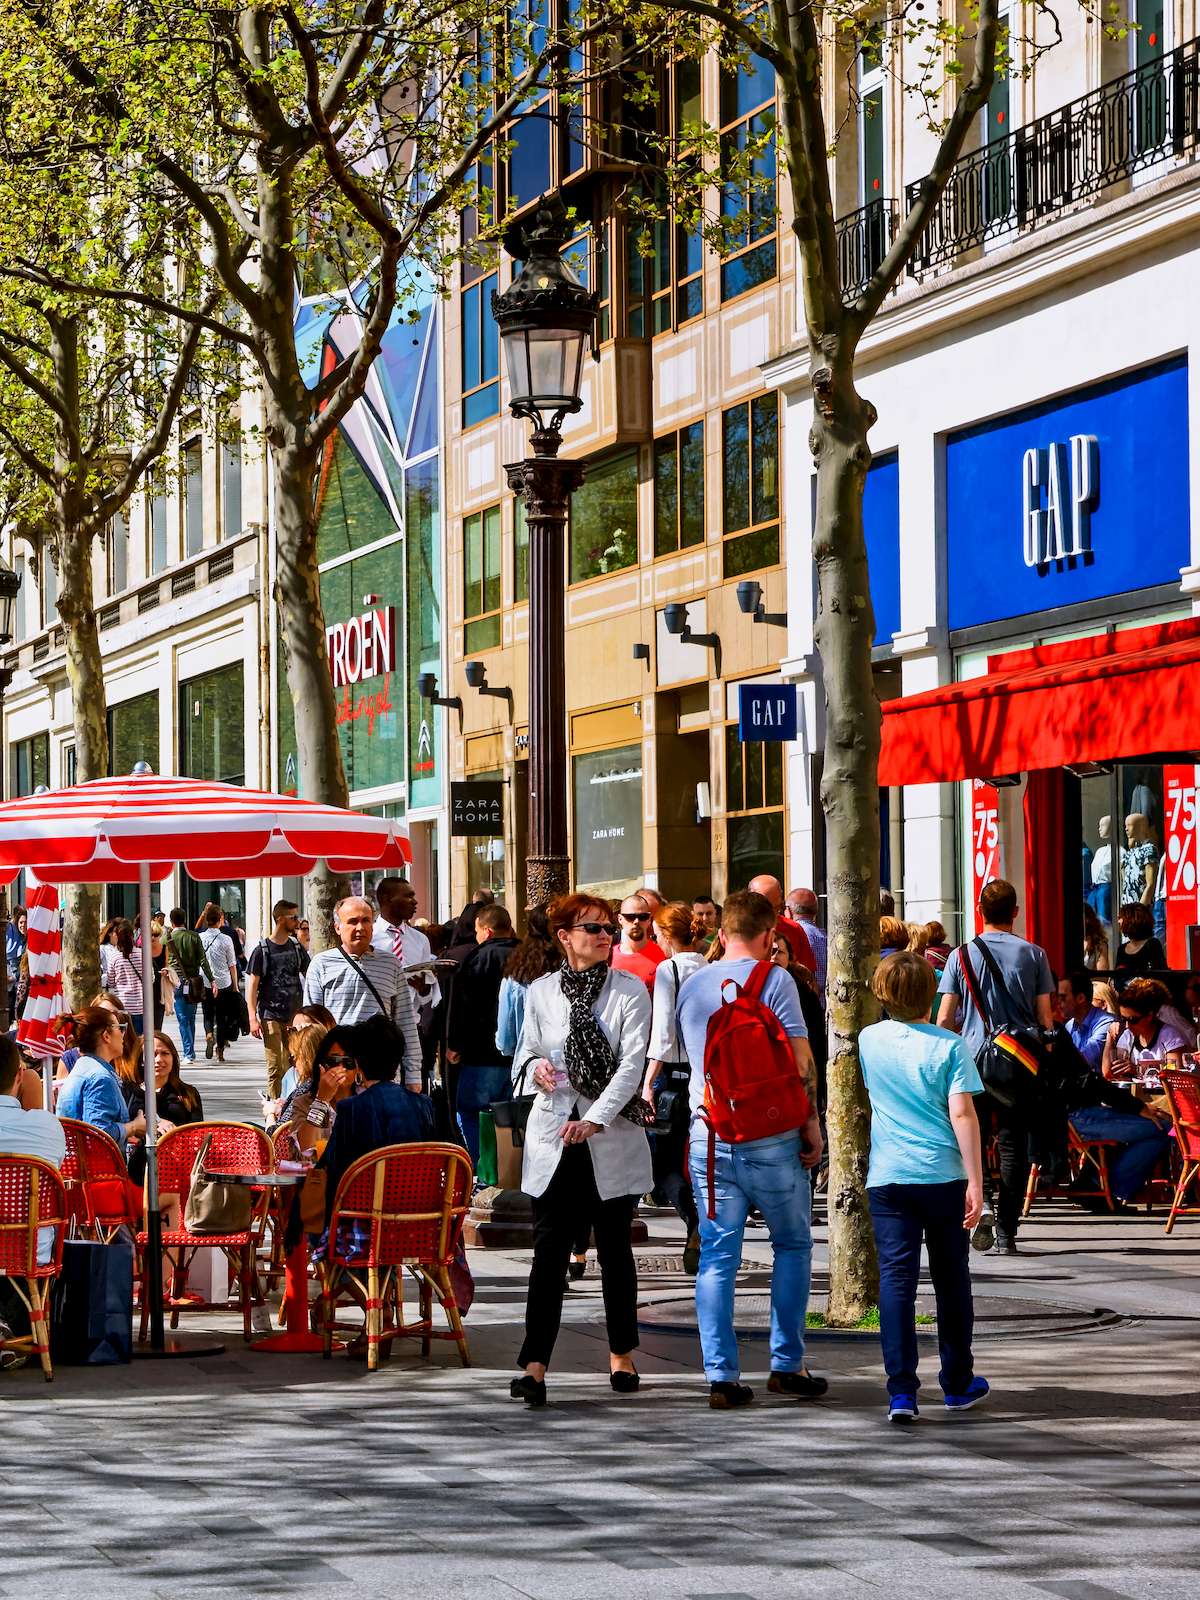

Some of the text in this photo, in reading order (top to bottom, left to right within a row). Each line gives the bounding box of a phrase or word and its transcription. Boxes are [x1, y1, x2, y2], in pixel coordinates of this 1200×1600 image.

[1022, 434, 1097, 567] GAP
[752, 699, 786, 726] GAP
[454, 812, 501, 822] HOME
[455, 799, 500, 809] ZARA
[1164, 787, 1196, 831] -75
[592, 829, 608, 839] ZARA
[973, 809, 999, 849] -75
